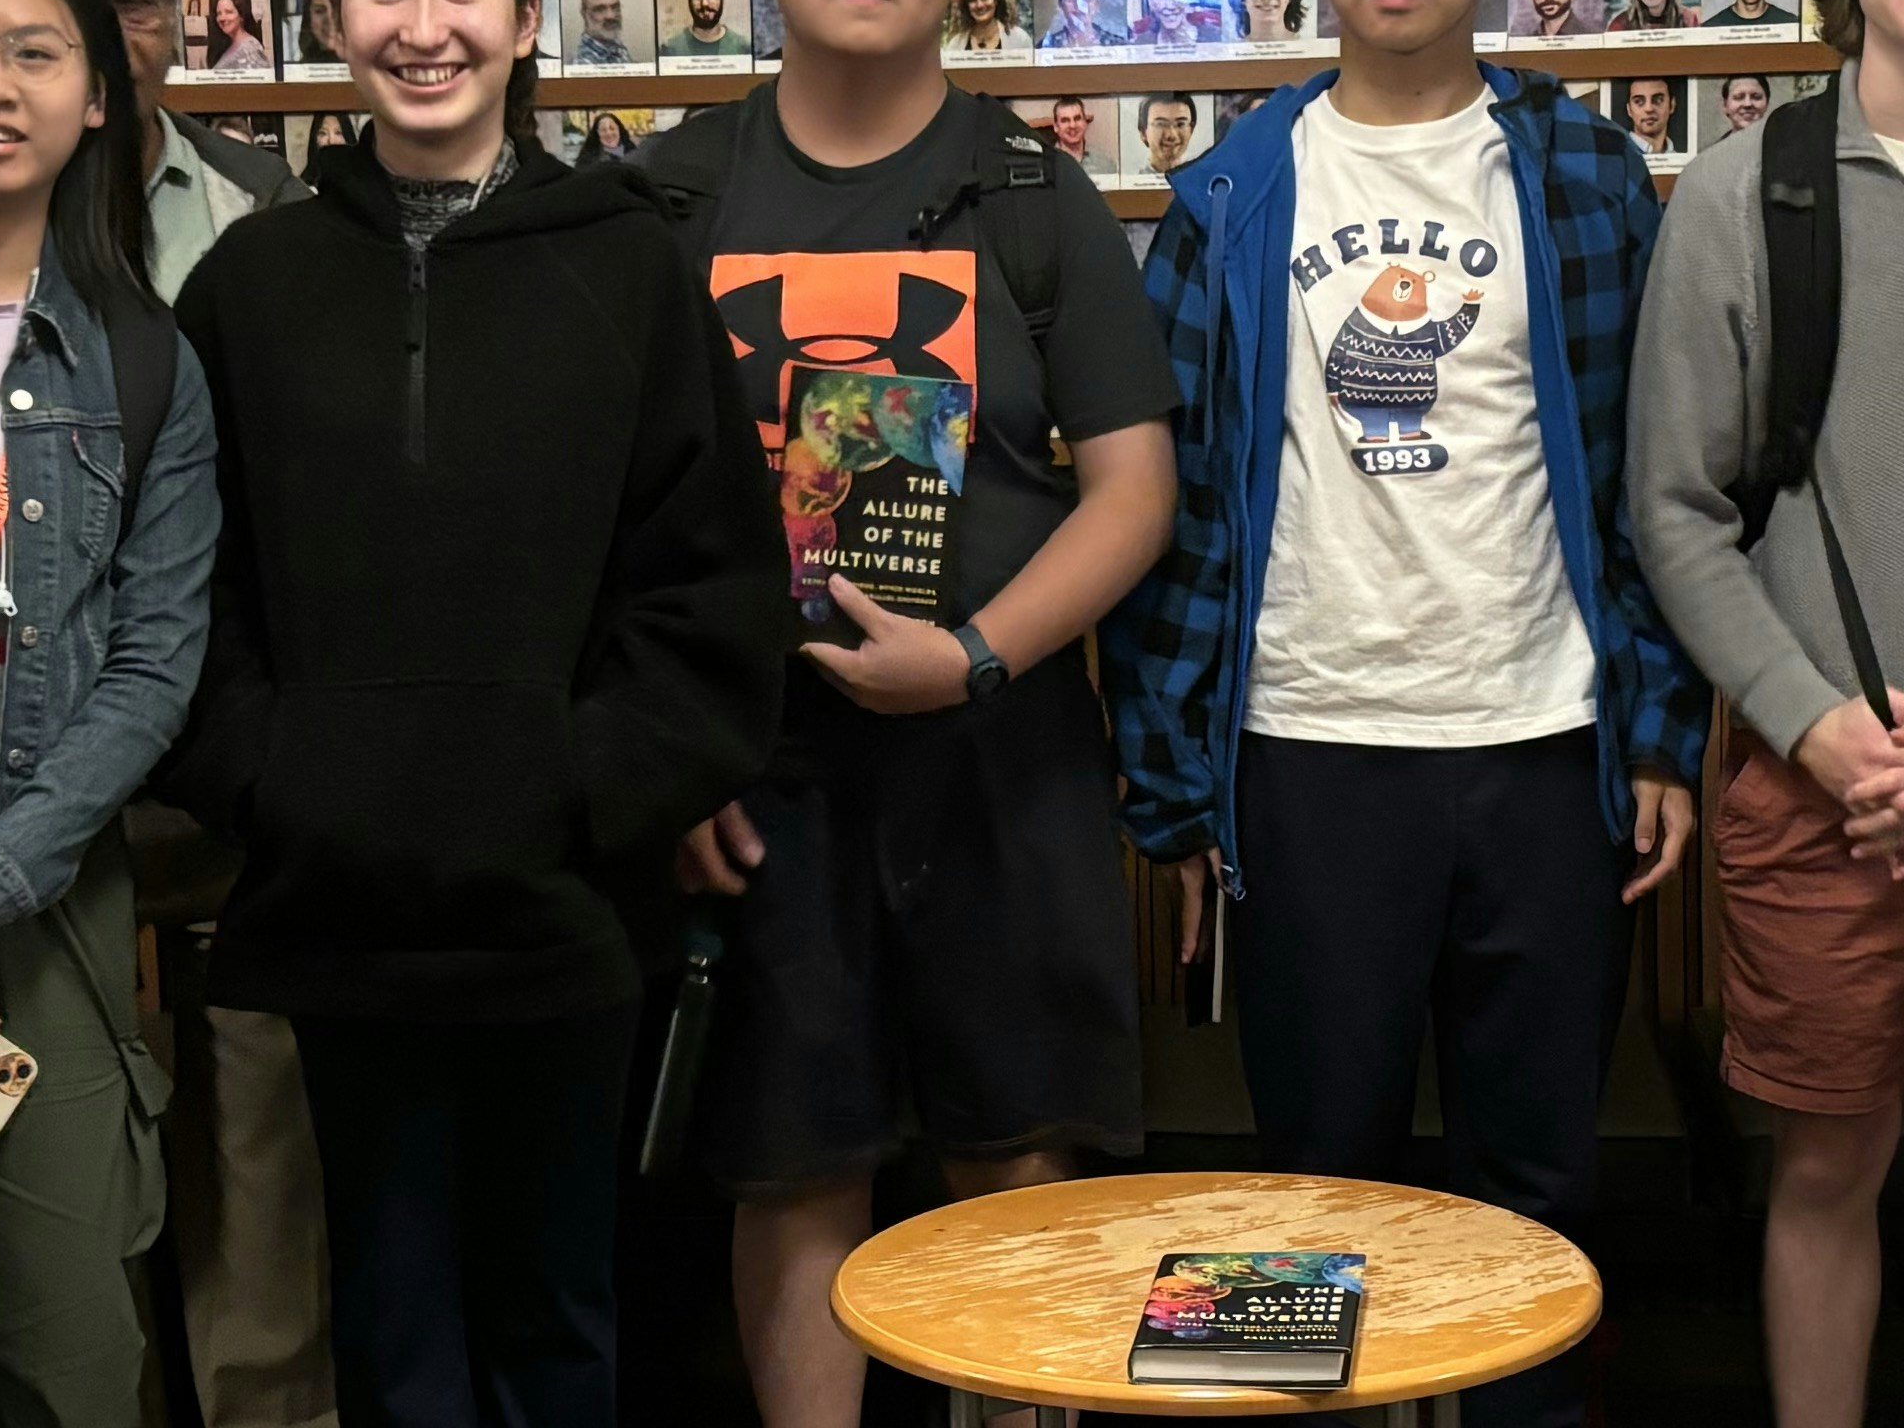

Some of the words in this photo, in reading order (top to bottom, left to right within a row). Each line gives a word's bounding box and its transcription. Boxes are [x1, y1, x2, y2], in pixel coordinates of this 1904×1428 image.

[1290, 218, 1498, 294] HELLO
[1362, 447, 1432, 472] 1993
[906, 475, 949, 496] THE
[862, 499, 947, 522] ALLURE
[864, 525, 894, 543] OF
[901, 529, 944, 549] THE
[803, 548, 942, 576] MULTIVERSE
[1246, 1296, 1344, 1304] ALLURE
[1296, 1286, 1345, 1294] THE
[1176, 1311, 1341, 1322] MULTIVERSE
[1247, 1305, 1282, 1313] OF
